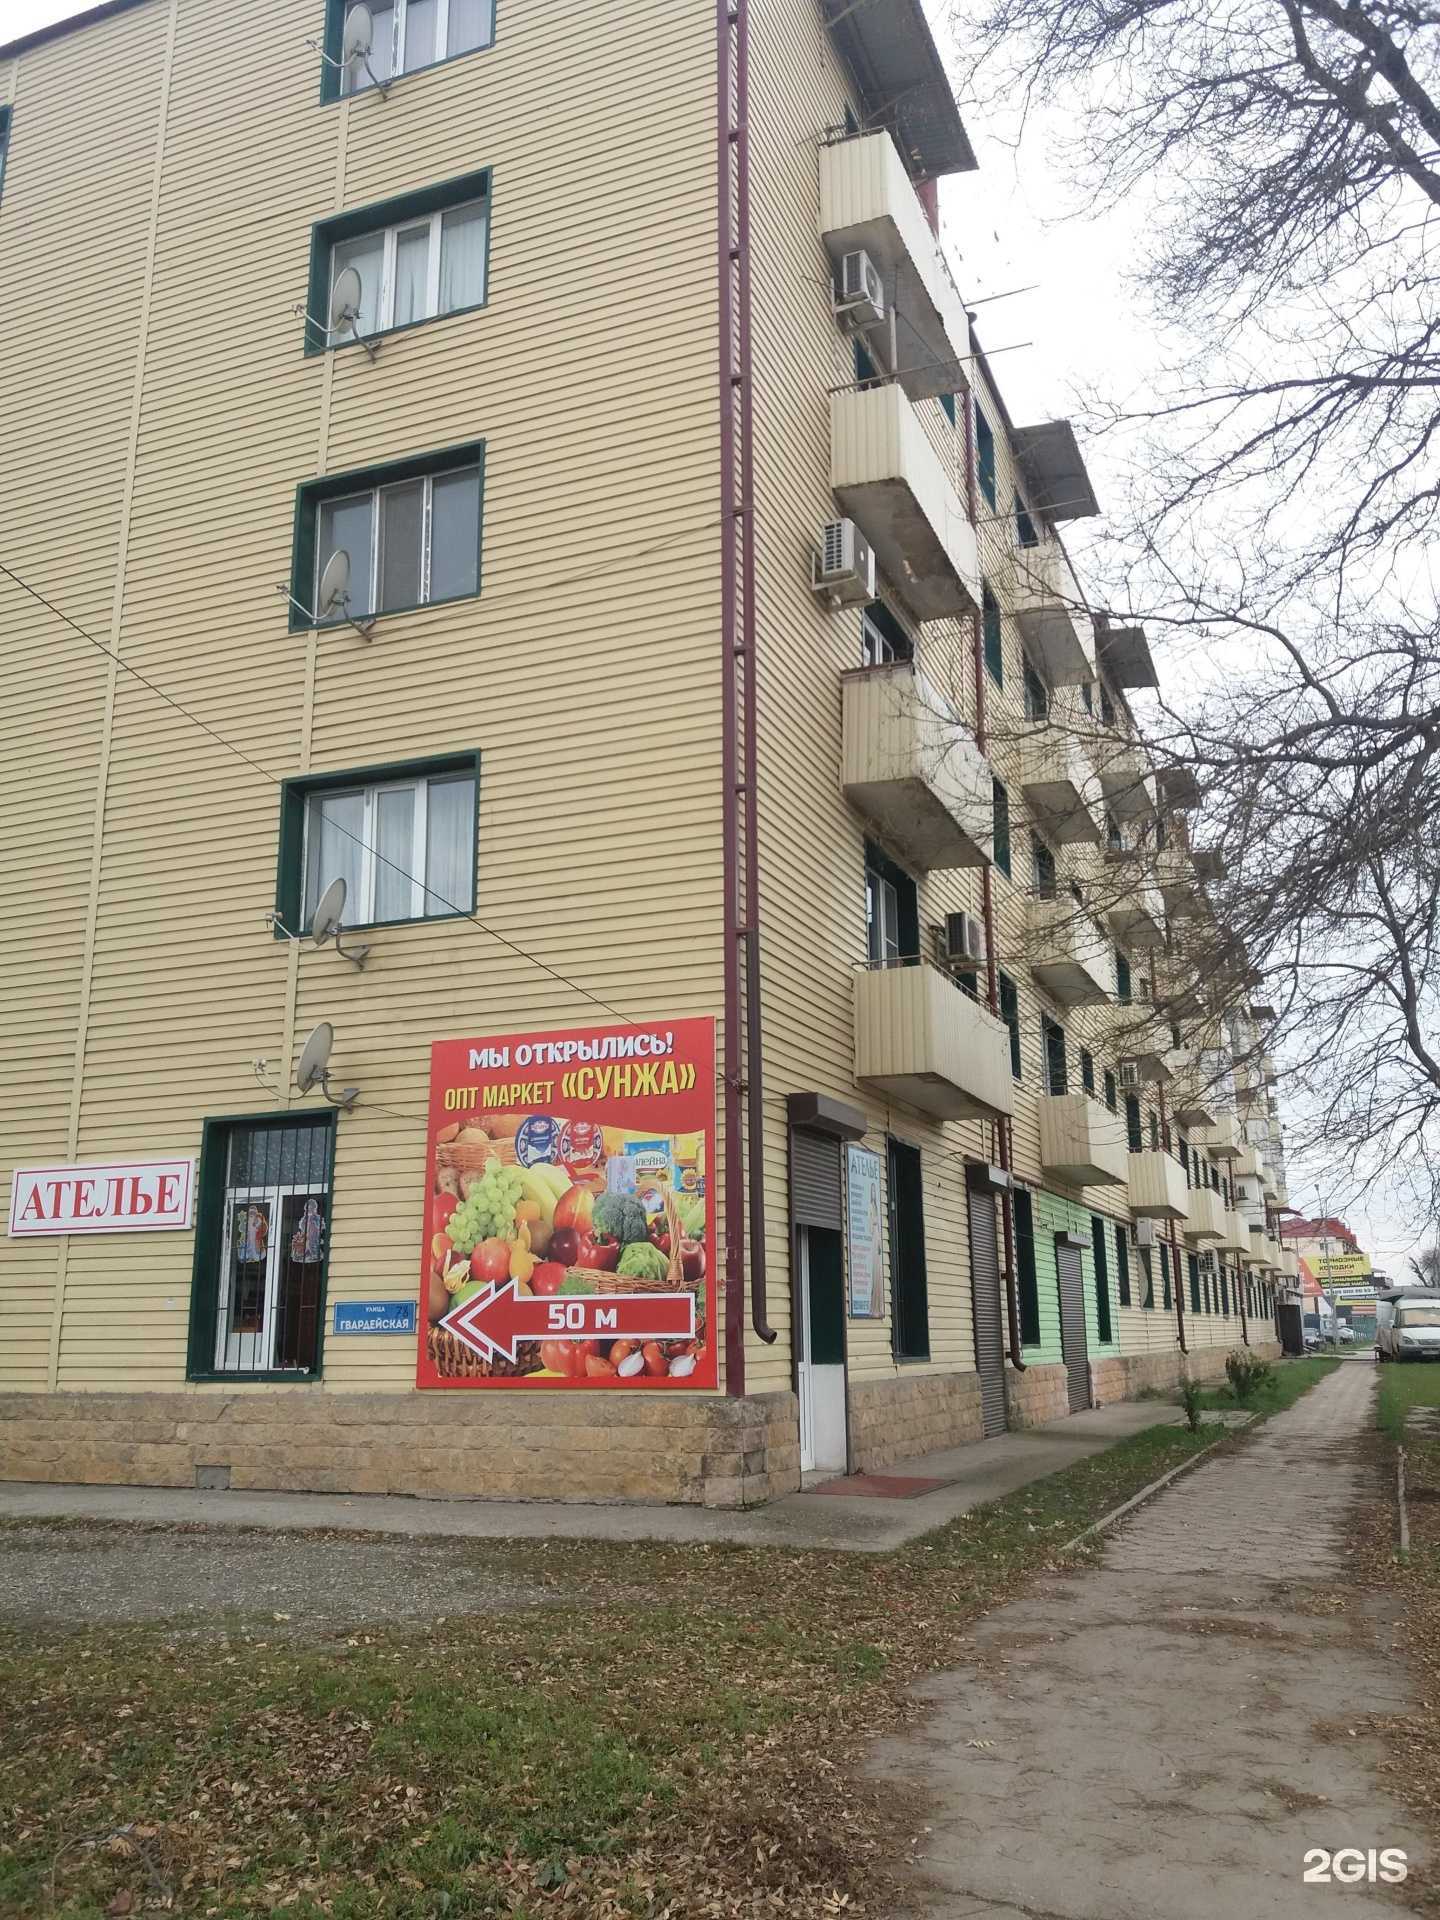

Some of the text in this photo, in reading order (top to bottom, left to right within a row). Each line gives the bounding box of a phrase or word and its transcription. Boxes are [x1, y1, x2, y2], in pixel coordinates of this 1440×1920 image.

[469, 1031, 674, 1069] МЫ ОТКРЫЛИСЬ!
[444, 1060, 697, 1111] ОПТ МАРКЕТ «СУНЖА»
[851, 1152, 879, 1180] АТЕЛЬЕ
[20, 1174, 181, 1221] АТЕЛЬЕ
[340, 1317, 409, 1330] ГВАРДЕЙСКАЯ
[547, 1303, 585, 1330] 50
